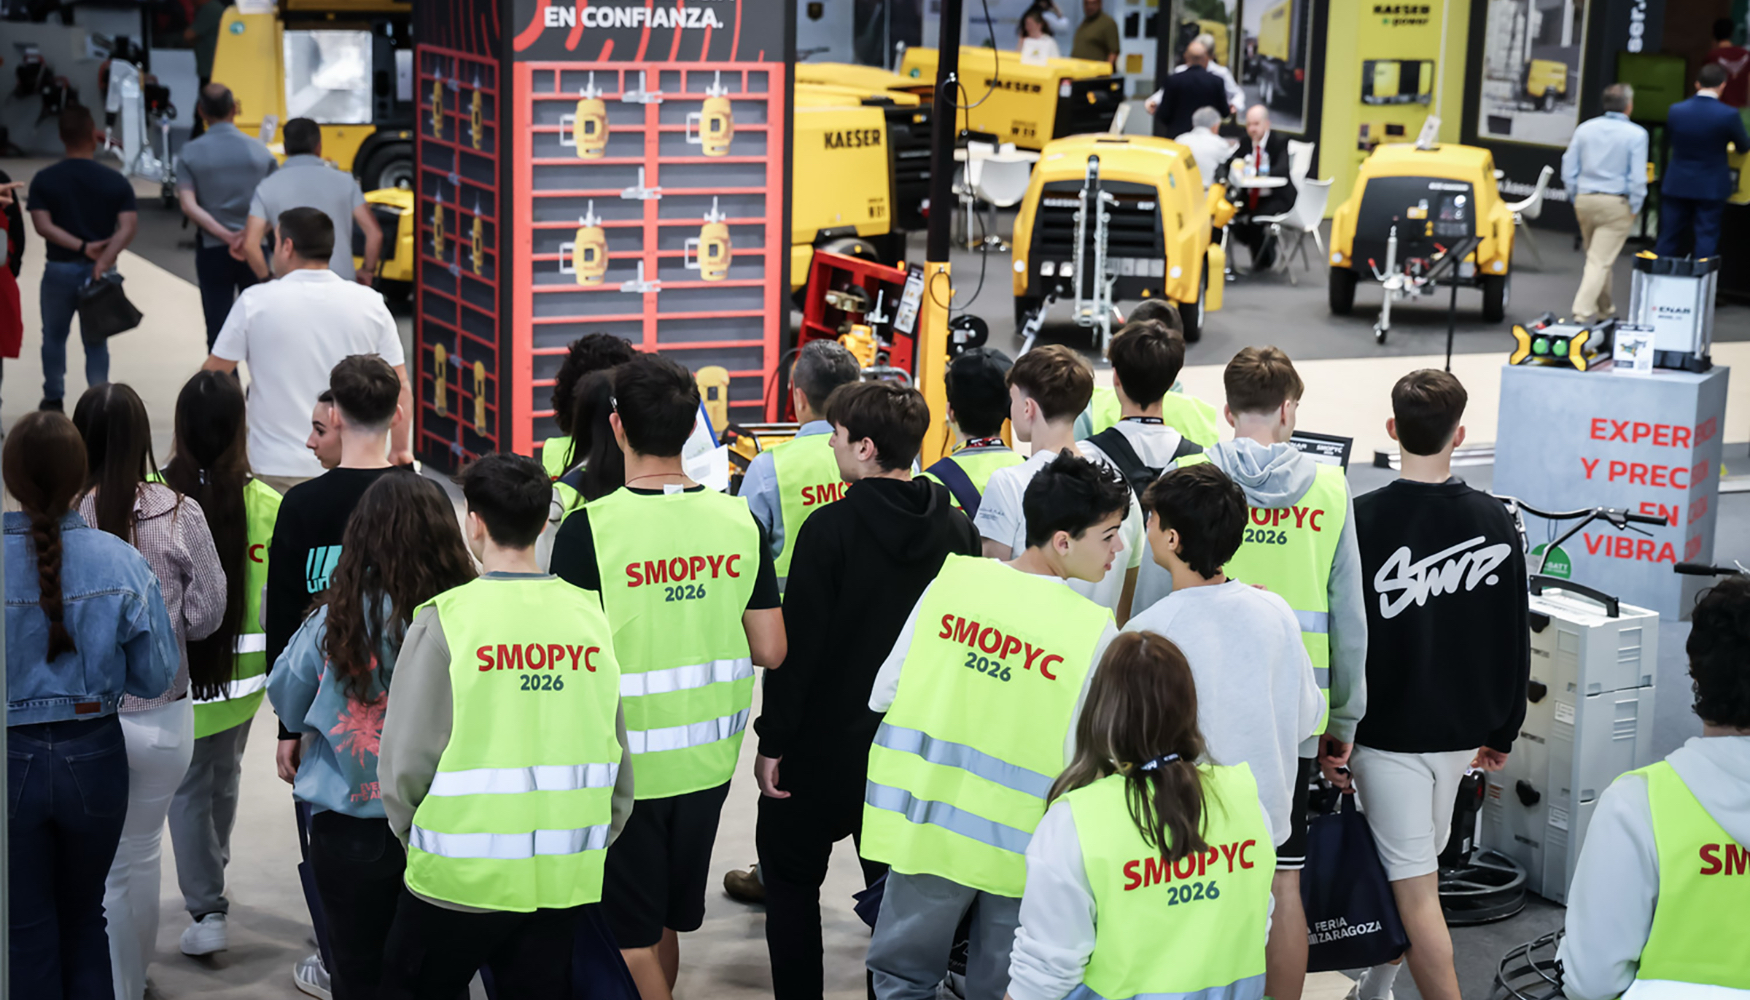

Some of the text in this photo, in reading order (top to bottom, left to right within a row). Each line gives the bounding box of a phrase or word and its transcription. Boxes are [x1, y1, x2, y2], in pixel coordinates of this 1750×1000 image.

[544, 6, 723, 29] EN CONFIANZA.
[824, 129, 881, 149] KAESER
[1590, 417, 1692, 449] EXPER
[1580, 457, 1600, 480] Y
[1608, 460, 1690, 490] PREC
[1244, 528, 1288, 545] 2026
[1583, 532, 1677, 565] VIBRA
[625, 554, 741, 588] SMOPYC
[664, 583, 706, 602] 2026
[476, 643, 601, 672] SMOPYC
[938, 613, 1065, 681] SMOPYC
[964, 651, 1013, 682] 2026
[519, 674, 565, 691] 2026
[1122, 839, 1257, 891] SMOPYC
[1166, 880, 1221, 906] 2026
[1314, 916, 1348, 932] FERIA
[1318, 920, 1383, 943] ZARAGOZA
